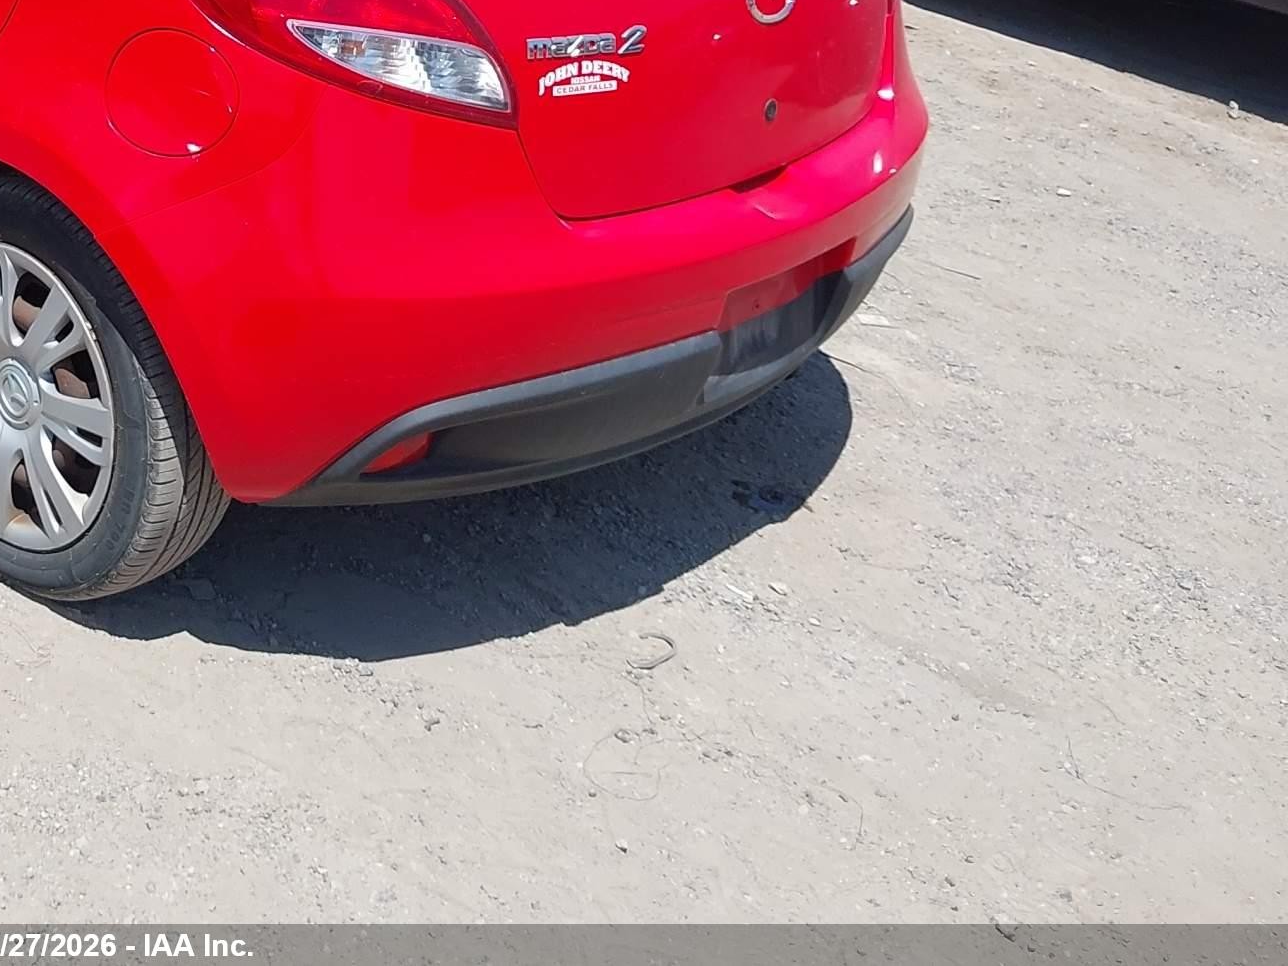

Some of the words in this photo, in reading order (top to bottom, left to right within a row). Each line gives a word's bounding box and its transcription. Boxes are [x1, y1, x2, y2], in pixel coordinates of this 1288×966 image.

[617, 24, 648, 55] 2
[538, 62, 579, 96] JOHN
[581, 60, 631, 82] DEERY
[556, 86, 586, 94] CEDAR
[588, 82, 614, 91] FALLS
